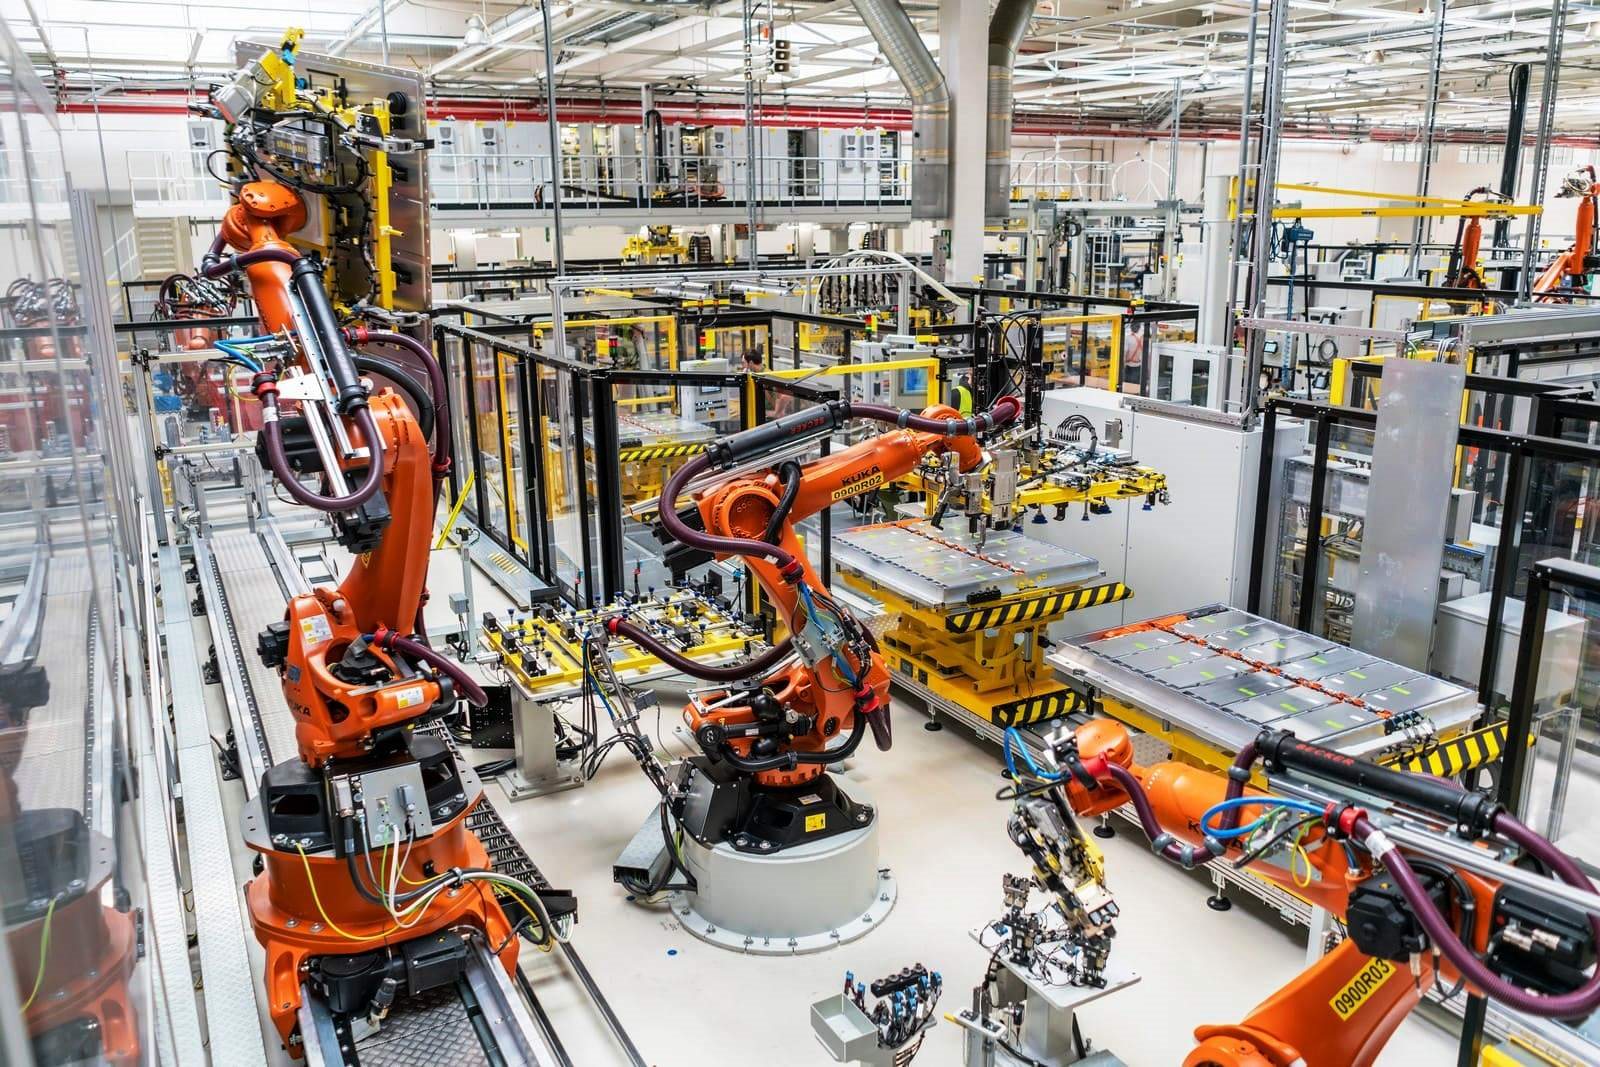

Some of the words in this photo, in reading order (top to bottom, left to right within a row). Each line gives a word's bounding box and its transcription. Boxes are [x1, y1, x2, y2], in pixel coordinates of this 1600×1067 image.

[833, 475, 882, 500] 0900R02
[841, 465, 880, 486] KUKA
[1334, 958, 1390, 1014] 0900R03
